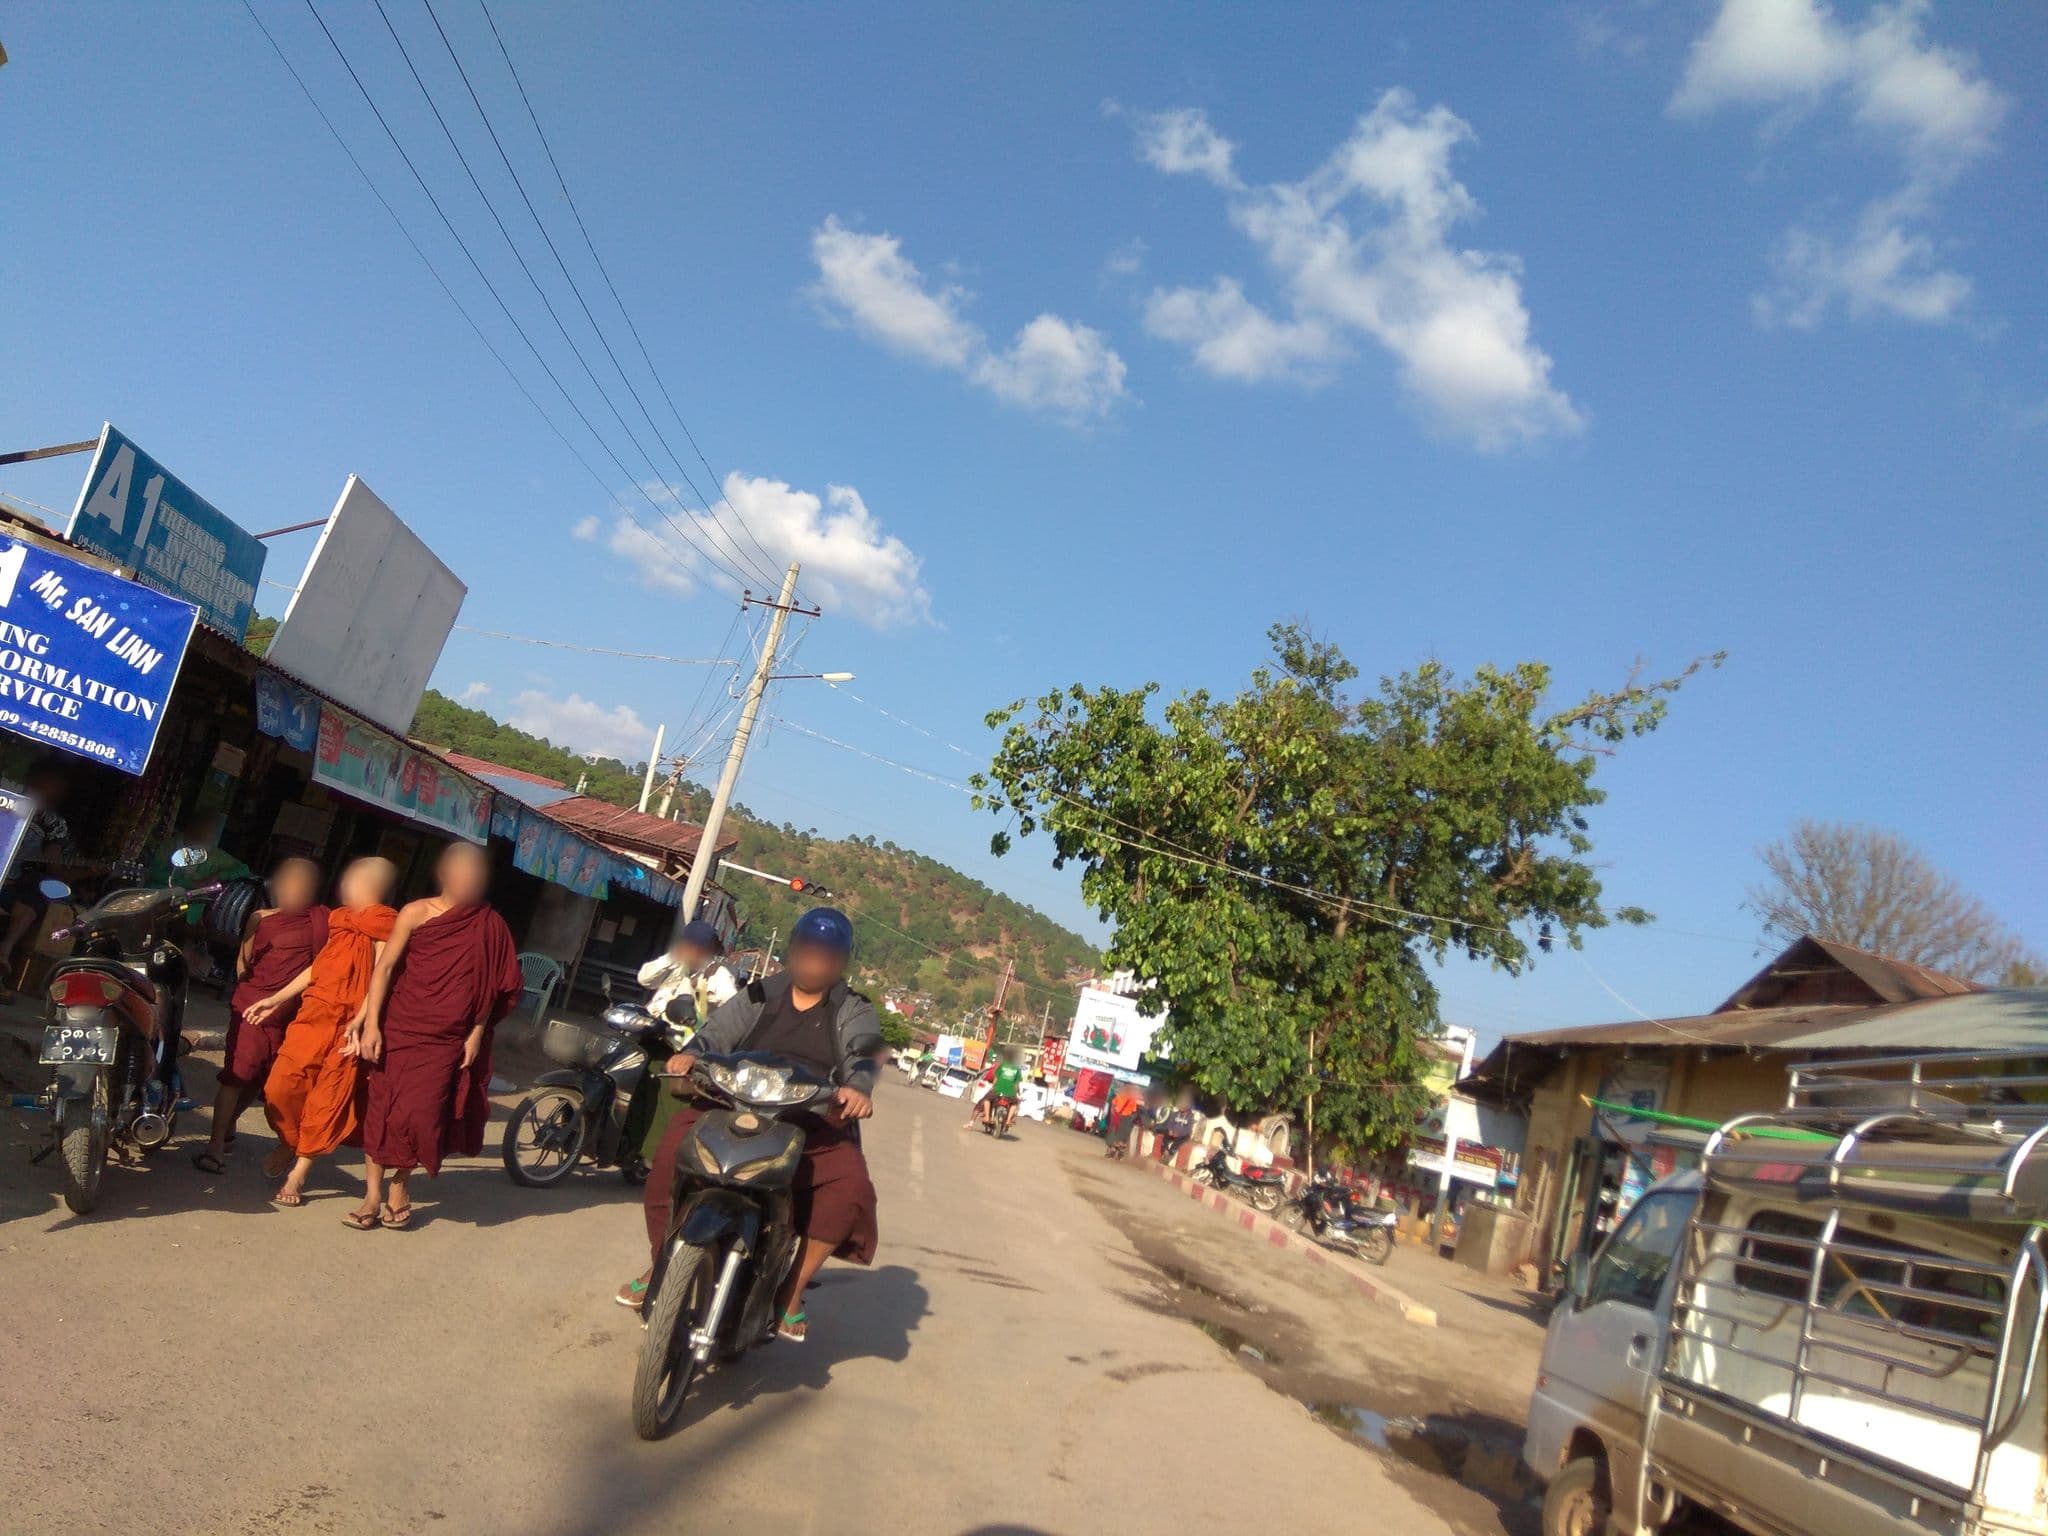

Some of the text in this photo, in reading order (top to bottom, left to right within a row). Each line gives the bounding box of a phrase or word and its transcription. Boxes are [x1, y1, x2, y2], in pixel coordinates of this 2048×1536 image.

[84, 443, 165, 549] A1
[158, 501, 226, 562] TREKKING
[145, 544, 183, 584] TAXI
[179, 565, 237, 619] SERVICE
[165, 530, 256, 603] INFORMATION
[64, 597, 117, 639] SAN
[105, 627, 163, 675] LINN
